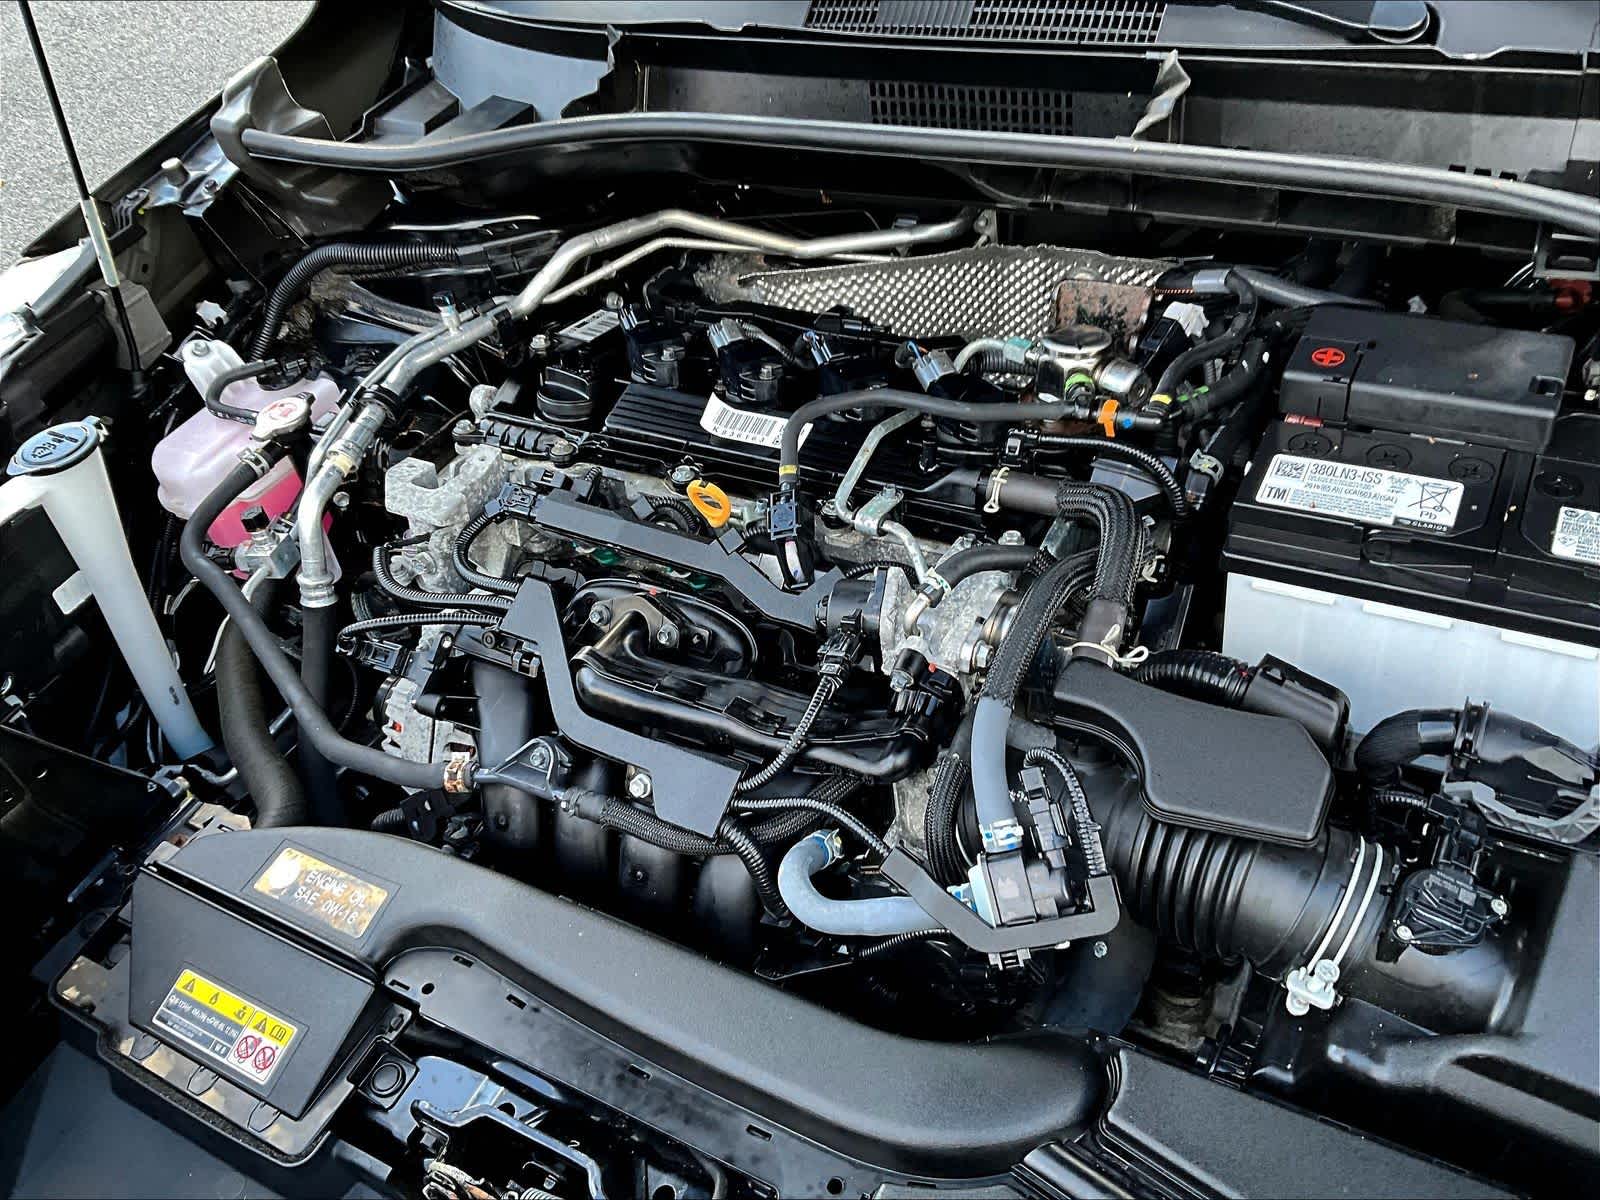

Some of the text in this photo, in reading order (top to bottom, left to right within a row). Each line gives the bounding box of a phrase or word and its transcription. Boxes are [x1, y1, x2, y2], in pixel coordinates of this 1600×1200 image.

[1310, 462, 1383, 485] 380LN3-ISS
[1267, 486, 1286, 500] TM
[1420, 510, 1437, 520] Pb
[1411, 520, 1449, 532] CLARIOS
[306, 870, 347, 896] ENGINE
[295, 886, 358, 924] SAE 0W-16
